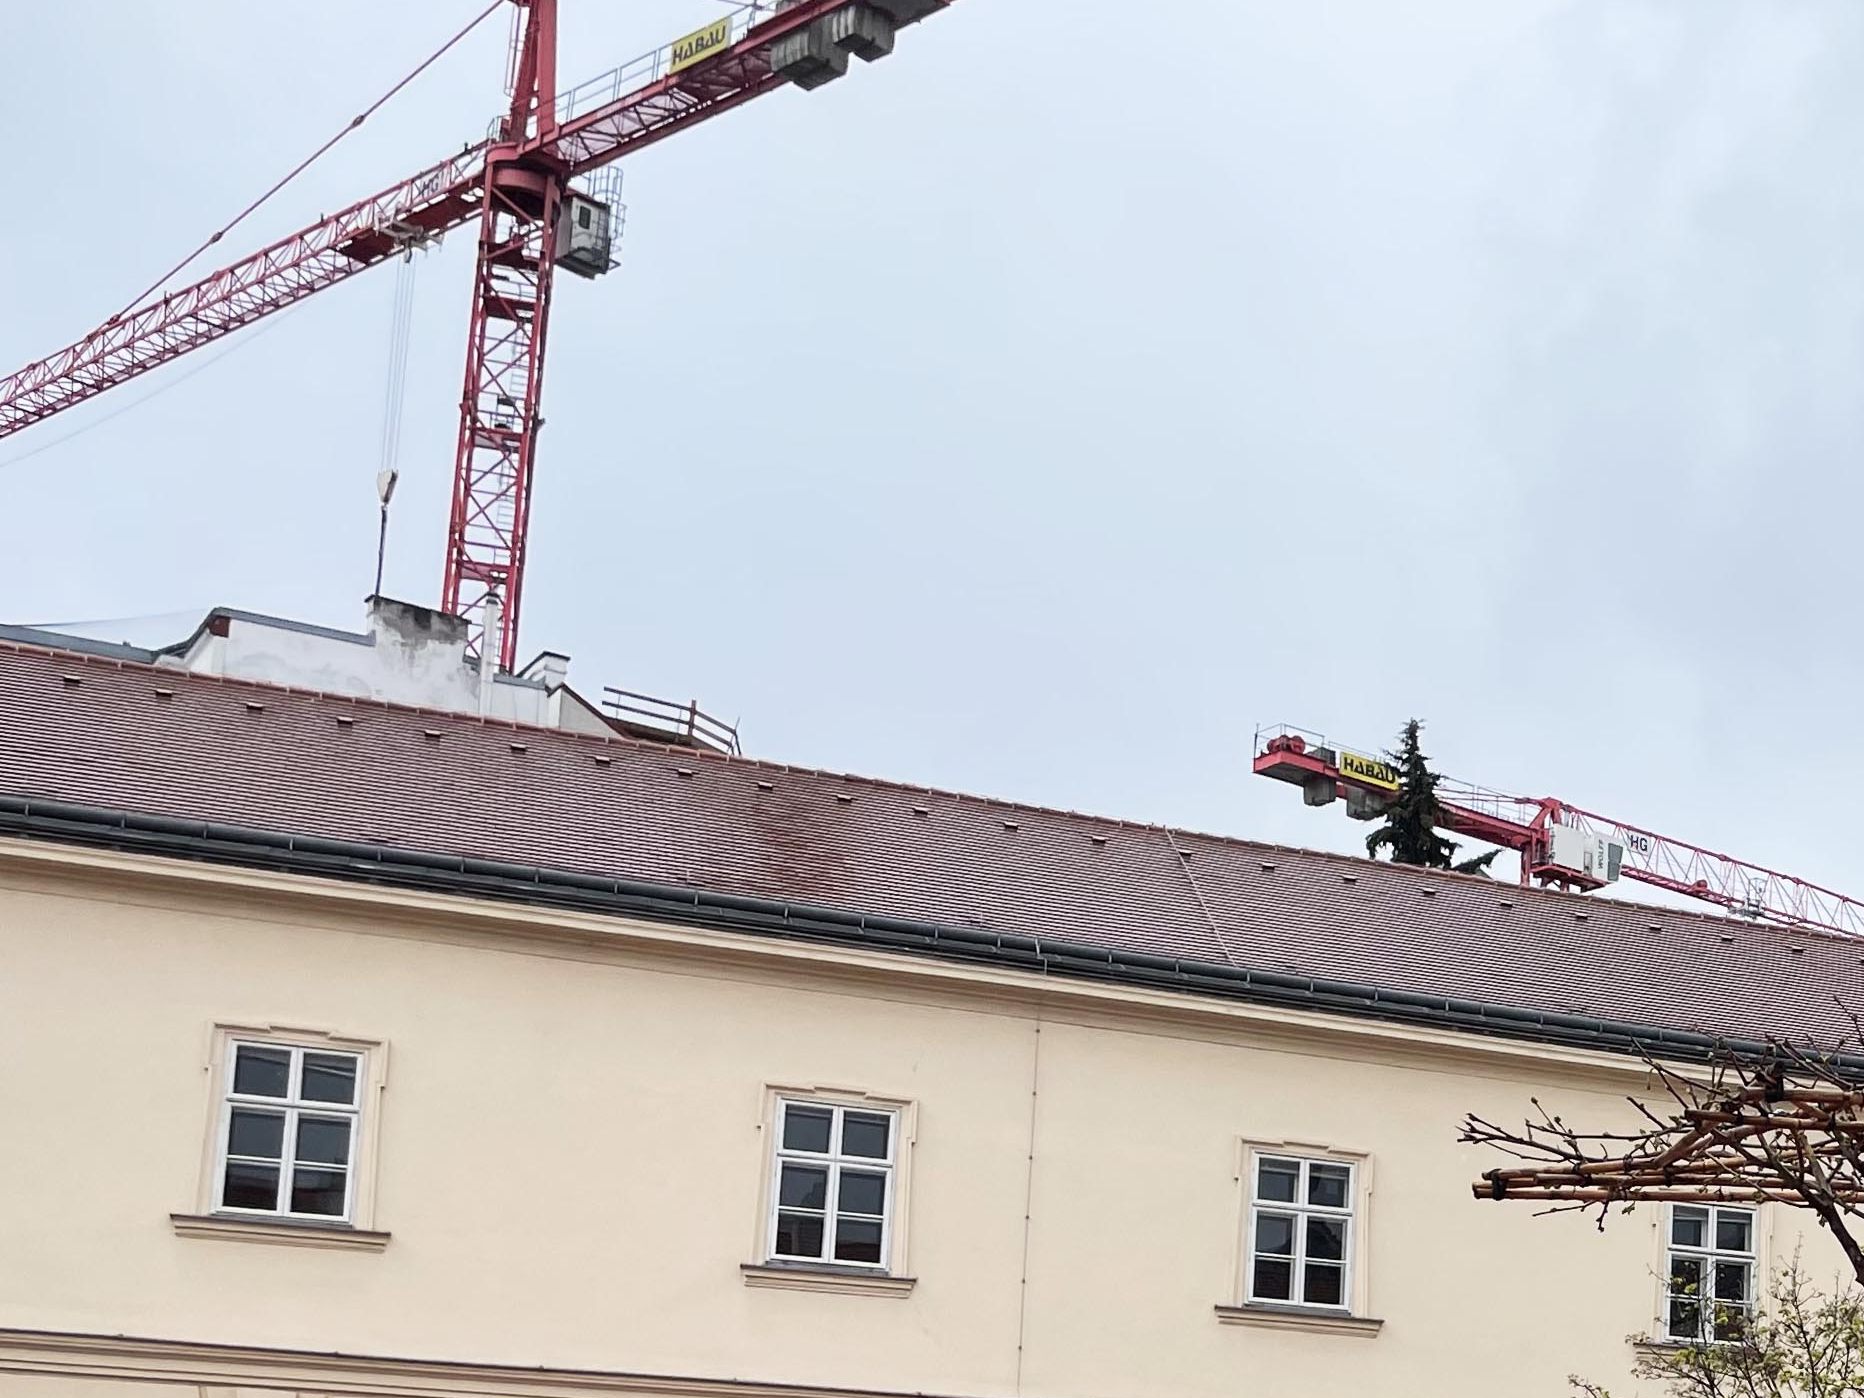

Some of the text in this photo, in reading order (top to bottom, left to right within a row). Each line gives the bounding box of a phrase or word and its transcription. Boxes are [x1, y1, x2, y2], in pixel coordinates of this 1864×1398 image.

[672, 25, 725, 65] HABAU
[1343, 756, 1395, 783] HABAU
[1630, 834, 1648, 852] HG
